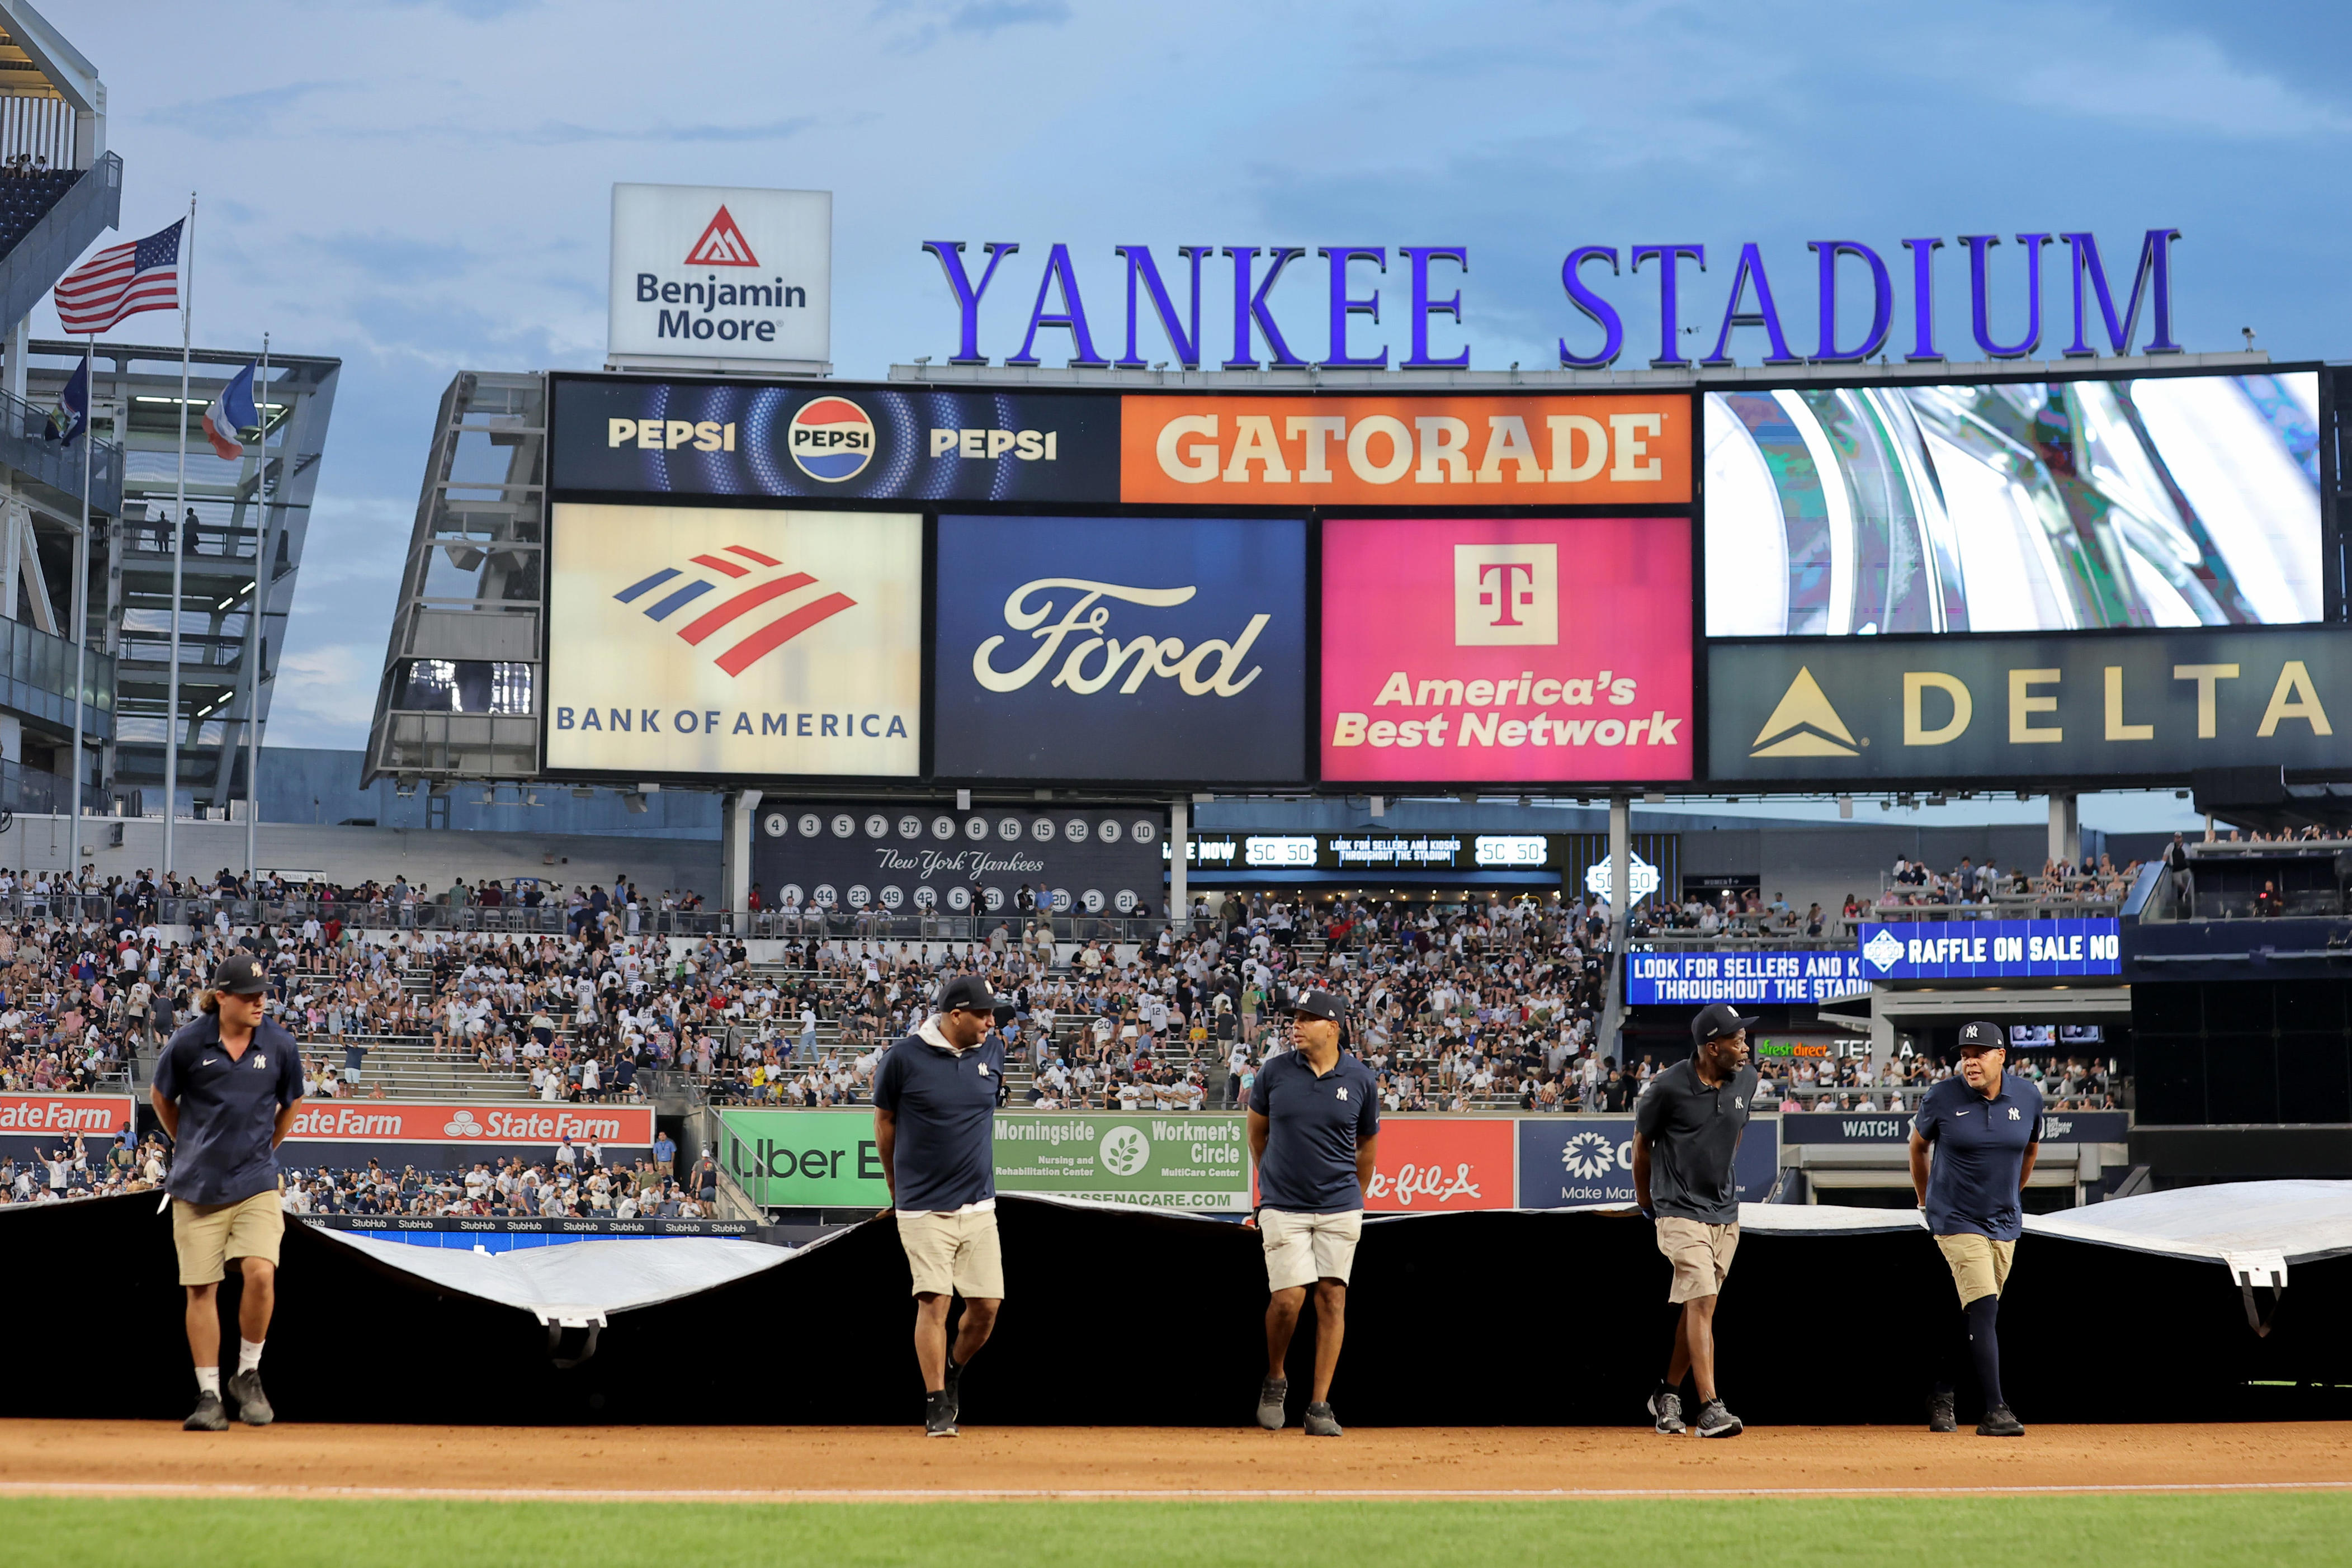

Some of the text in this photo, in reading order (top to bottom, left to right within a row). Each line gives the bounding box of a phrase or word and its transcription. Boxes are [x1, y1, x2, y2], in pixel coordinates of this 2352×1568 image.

[636, 272, 806, 312] Benjamin
[922, 228, 2185, 371] YANKEE STADIUM
[658, 310, 776, 342] Moore
[608, 418, 735, 452] PEPSI
[795, 429, 869, 449] PEPSI
[930, 429, 1057, 461] PEPSI
[1156, 413, 1662, 484] GATORADE
[973, 577, 1271, 697] Ford
[1373, 670, 1637, 706] America's
[1902, 660, 2333, 747] DELTA
[557, 706, 908, 738] BANK OF AMERICA
[1332, 711, 1682, 748] Best Network
[772, 820, 780, 830] 4
[806, 820, 813, 831] 3
[839, 820, 847, 832] 5
[873, 821, 881, 832] 7
[903, 821, 918, 833] 37
[940, 822, 947, 833] 8
[973, 823, 980, 834] 8
[1004, 824, 1016, 835] 16
[1037, 824, 1050, 835] 15
[1069, 825, 1084, 836] 32
[1106, 825, 1113, 837] 9
[1137, 826, 1150, 837] 10
[1200, 842, 1236, 859] NOW
[1330, 840, 1461, 851] LOOK FOR SELLERS AND KIOSKS
[1340, 851, 1451, 861] THROUGHOUT THE STADIUM
[875, 848, 1044, 880] New York Yankees
[817, 890, 833, 901] 44
[852, 891, 866, 902] 23
[884, 891, 899, 903] 49
[917, 892, 933, 903] 42
[955, 892, 962, 904] 6
[986, 894, 999, 904] 51
[1054, 895, 1066, 905] 20
[1089, 895, 1097, 906] 2
[1120, 896, 1134, 907] 21
[1908, 934, 2119, 964] RAFFLE ON SALE NO
[1634, 956, 1860, 979] LOOK FOR SELLERS AND K
[1655, 979, 1873, 1000] THROUGHOUT THE STADIU
[1098, 1021, 1110, 1029] 20
[1758, 1039, 1827, 1057] freshdirect
[0, 1102, 111, 1129] ateFarm
[288, 1108, 402, 1135] ateFarm
[994, 1120, 1095, 1146] Morningside
[1151, 1121, 1241, 1141] Workmen's
[1843, 1121, 1899, 1137] WATCH
[733, 1138, 845, 1179] Uber
[1191, 1143, 1240, 1164] Circle
[1038, 1155, 1094, 1166] Nursing and
[995, 1166, 1094, 1177] Rehabilitation Center
[1161, 1168, 1240, 1178] MultiCare Center
[1562, 1186, 1602, 1199] Make
[1606, 1186, 1637, 1201] Mar
[352, 1219, 387, 1229] StubHub
[398, 1220, 433, 1229] StubHub
[460, 1221, 495, 1230] StubHub
[507, 1221, 542, 1231] StubHub
[563, 1222, 598, 1231] StubHub
[610, 1222, 644, 1232] StubHub
[665, 1223, 700, 1232] StubHub
[711, 1224, 746, 1233] StubHub
